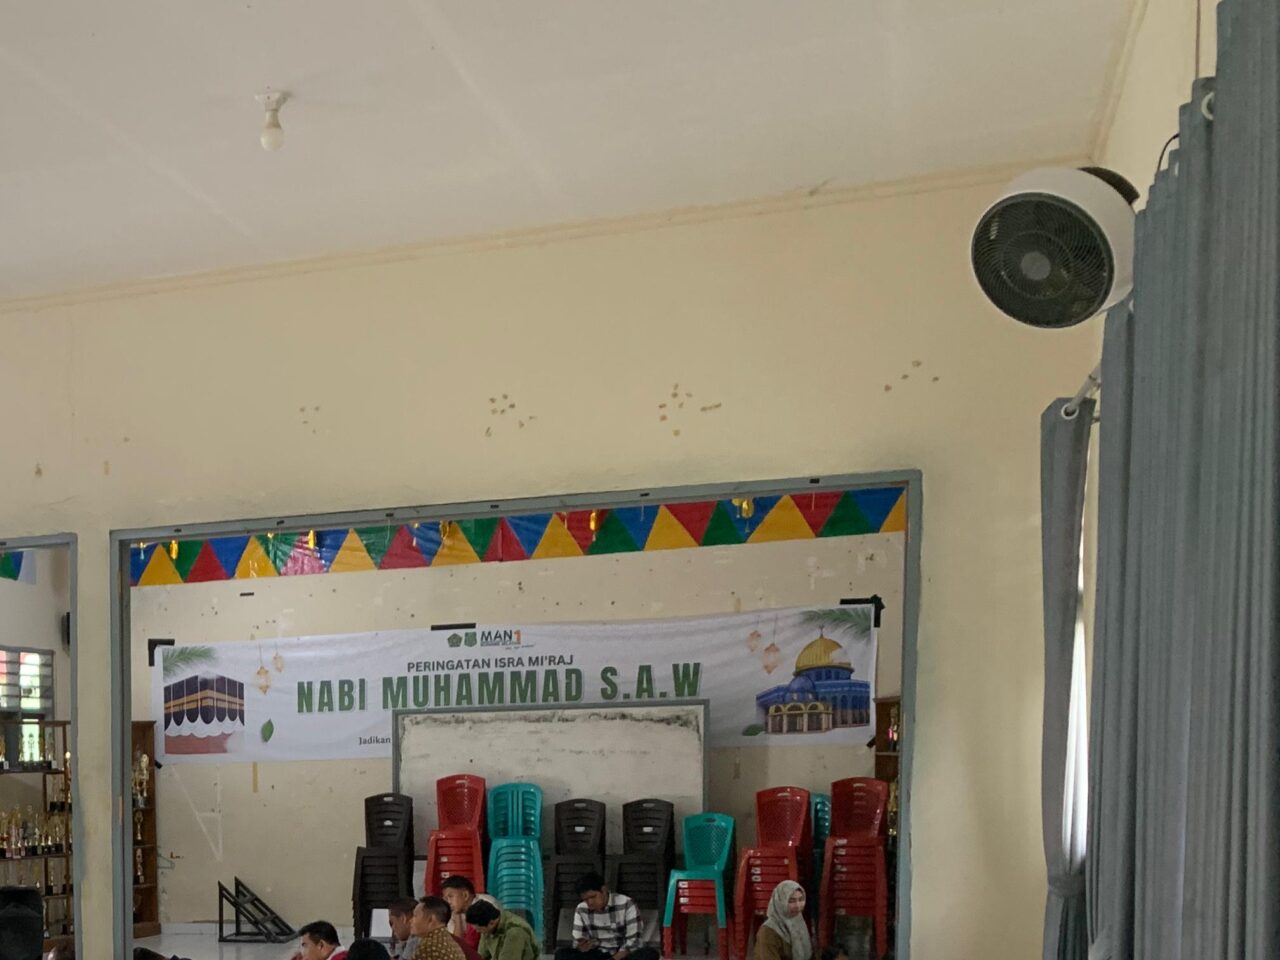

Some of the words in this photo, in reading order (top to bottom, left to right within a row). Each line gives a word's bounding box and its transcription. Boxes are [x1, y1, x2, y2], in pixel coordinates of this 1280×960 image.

[407, 658, 491, 673] PERINGATAN
[495, 656, 524, 669] ISRA
[528, 654, 574, 668] MI'RAJ
[297, 678, 368, 713] NABI
[382, 667, 585, 710] MUHAMMAD
[600, 662, 702, 699] S.A.W
[358, 735, 391, 746] Jadikan
